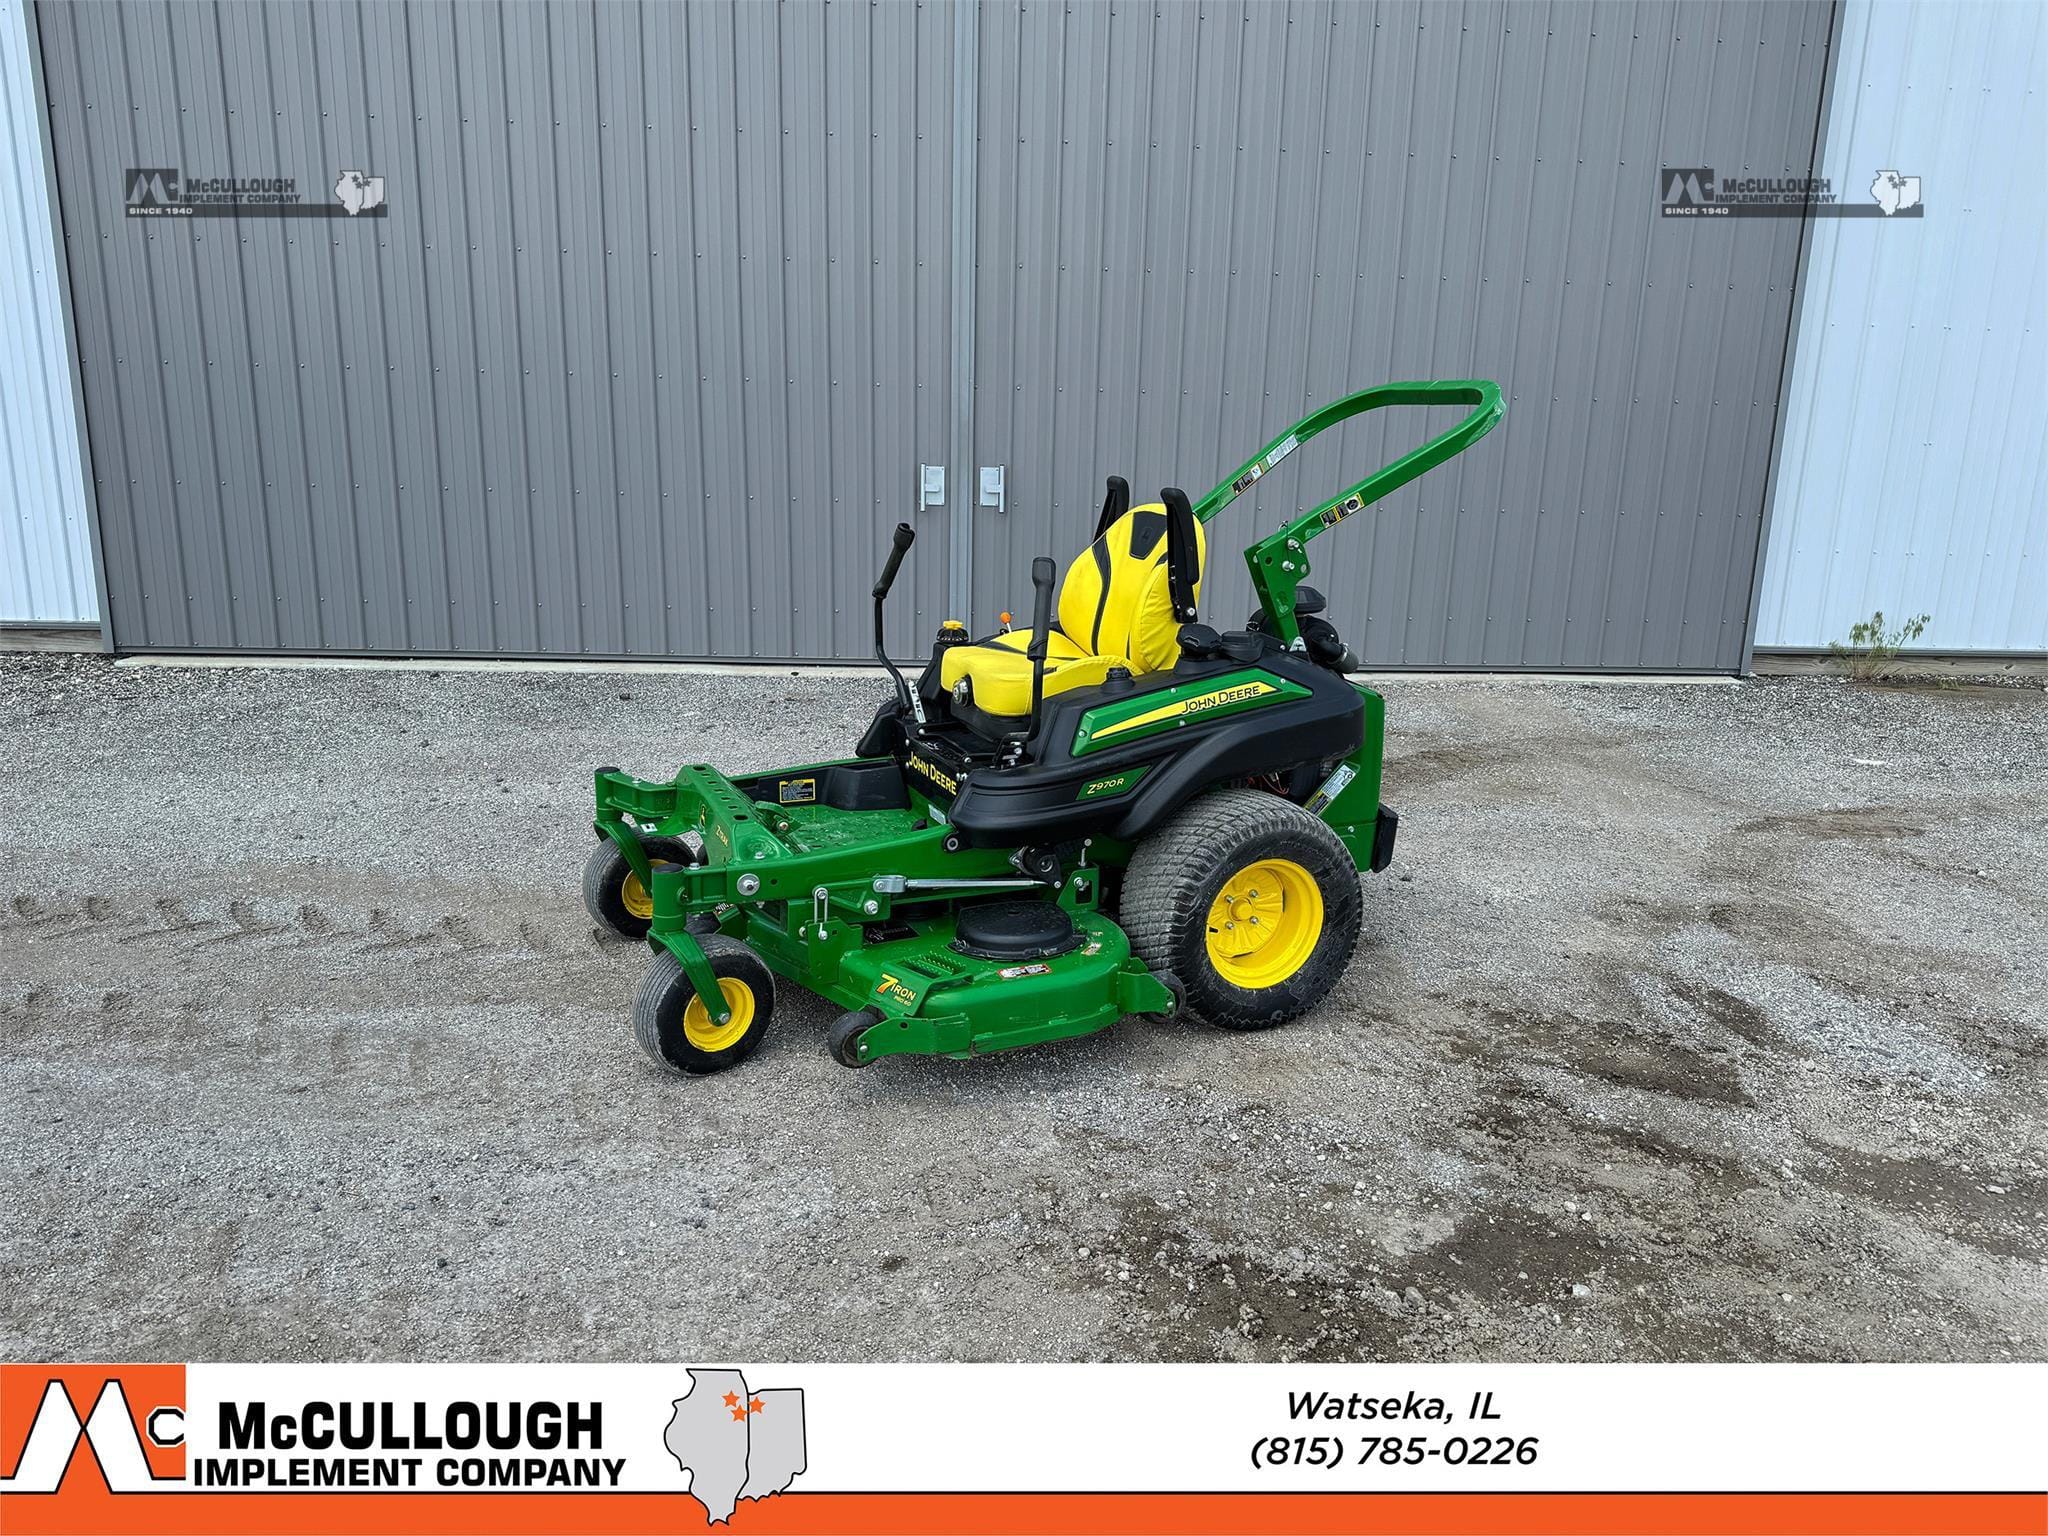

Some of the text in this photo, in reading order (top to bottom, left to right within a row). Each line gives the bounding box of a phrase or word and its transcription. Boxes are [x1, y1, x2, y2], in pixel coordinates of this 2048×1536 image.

[1182, 685, 1260, 714] JOHN DEERE
[908, 751, 957, 796] JOHN DEERE
